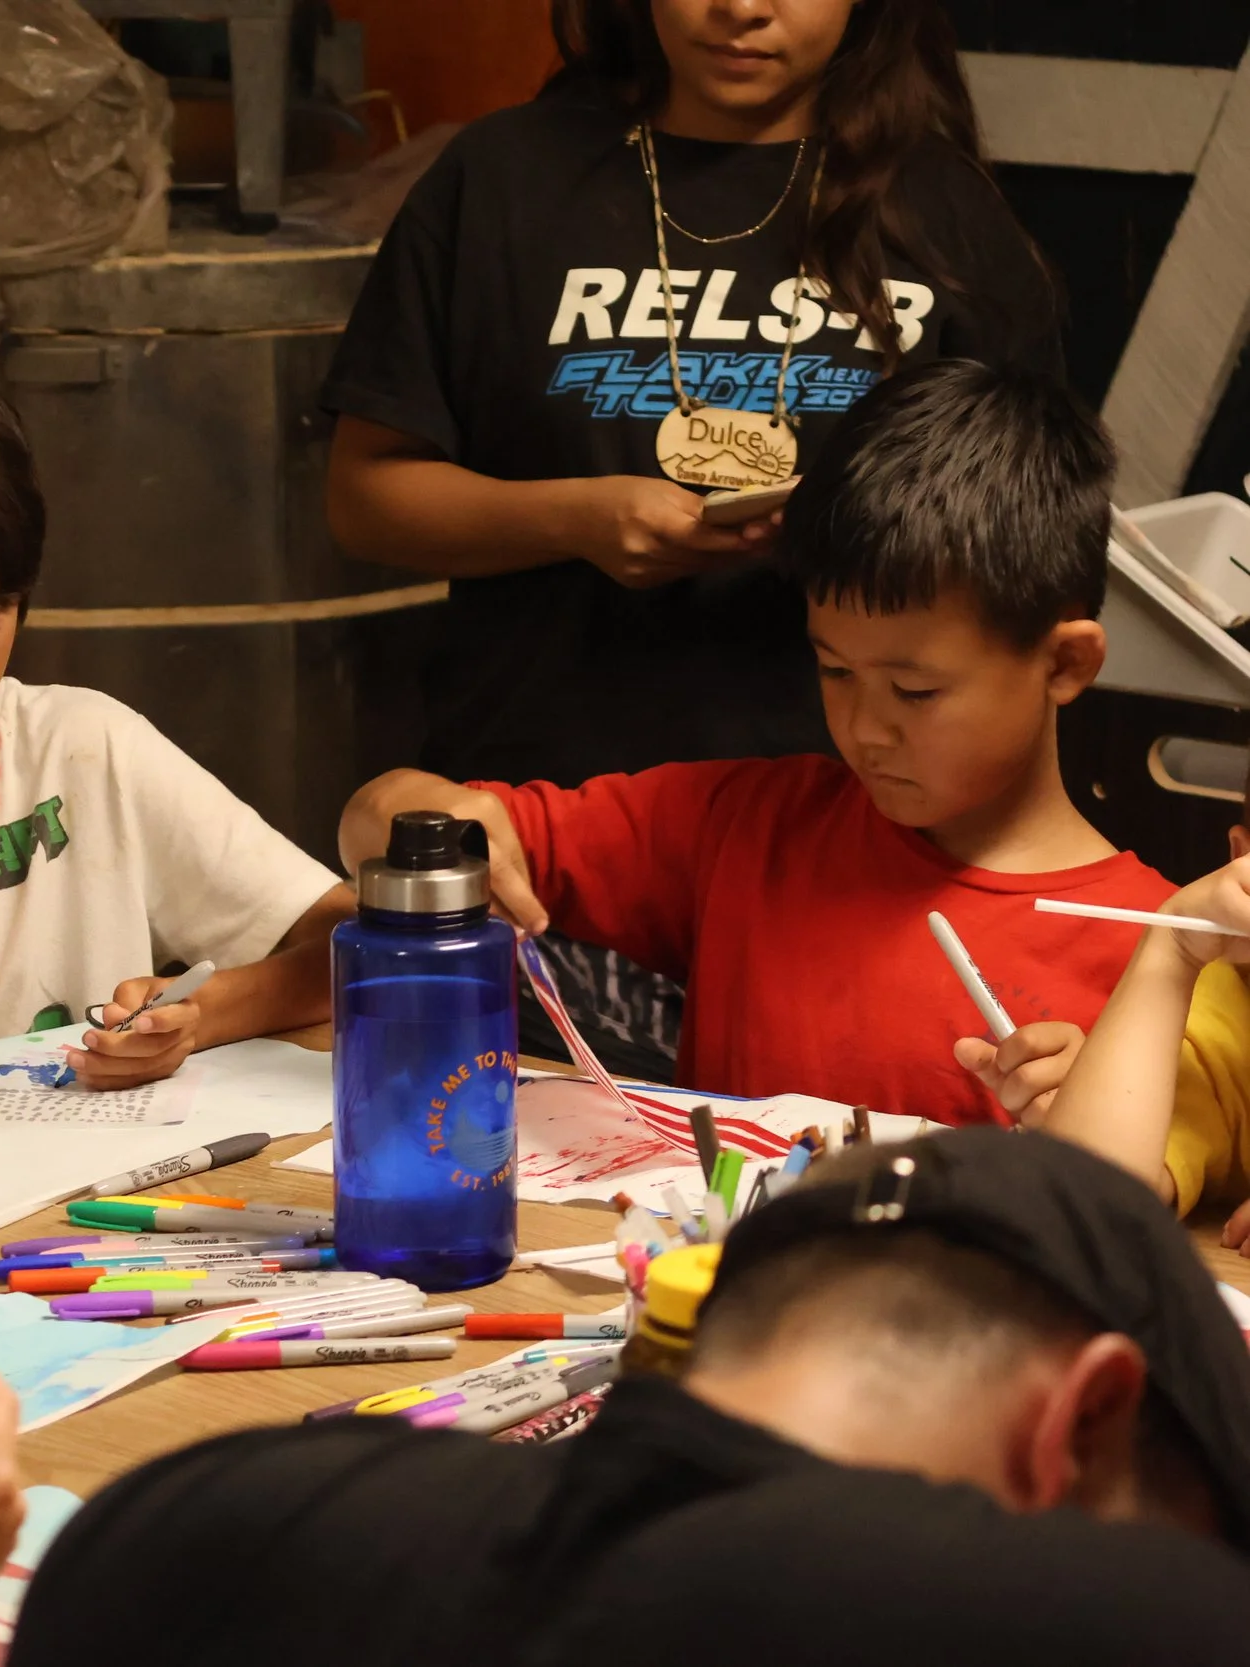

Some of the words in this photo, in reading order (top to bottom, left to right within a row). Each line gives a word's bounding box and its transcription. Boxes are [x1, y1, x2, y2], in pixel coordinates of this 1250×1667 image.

[549, 351, 820, 391] FLAKK
[814, 367, 882, 384] MEXI
[802, 389, 867, 405] 20
[689, 418, 762, 449] Dulce
[427, 1097, 447, 1155] TAKE
[442, 1064, 472, 1094] ME
[475, 1050, 497, 1070] TO
[452, 1169, 486, 1191] EST.
[492, 1157, 513, 1188] 198
